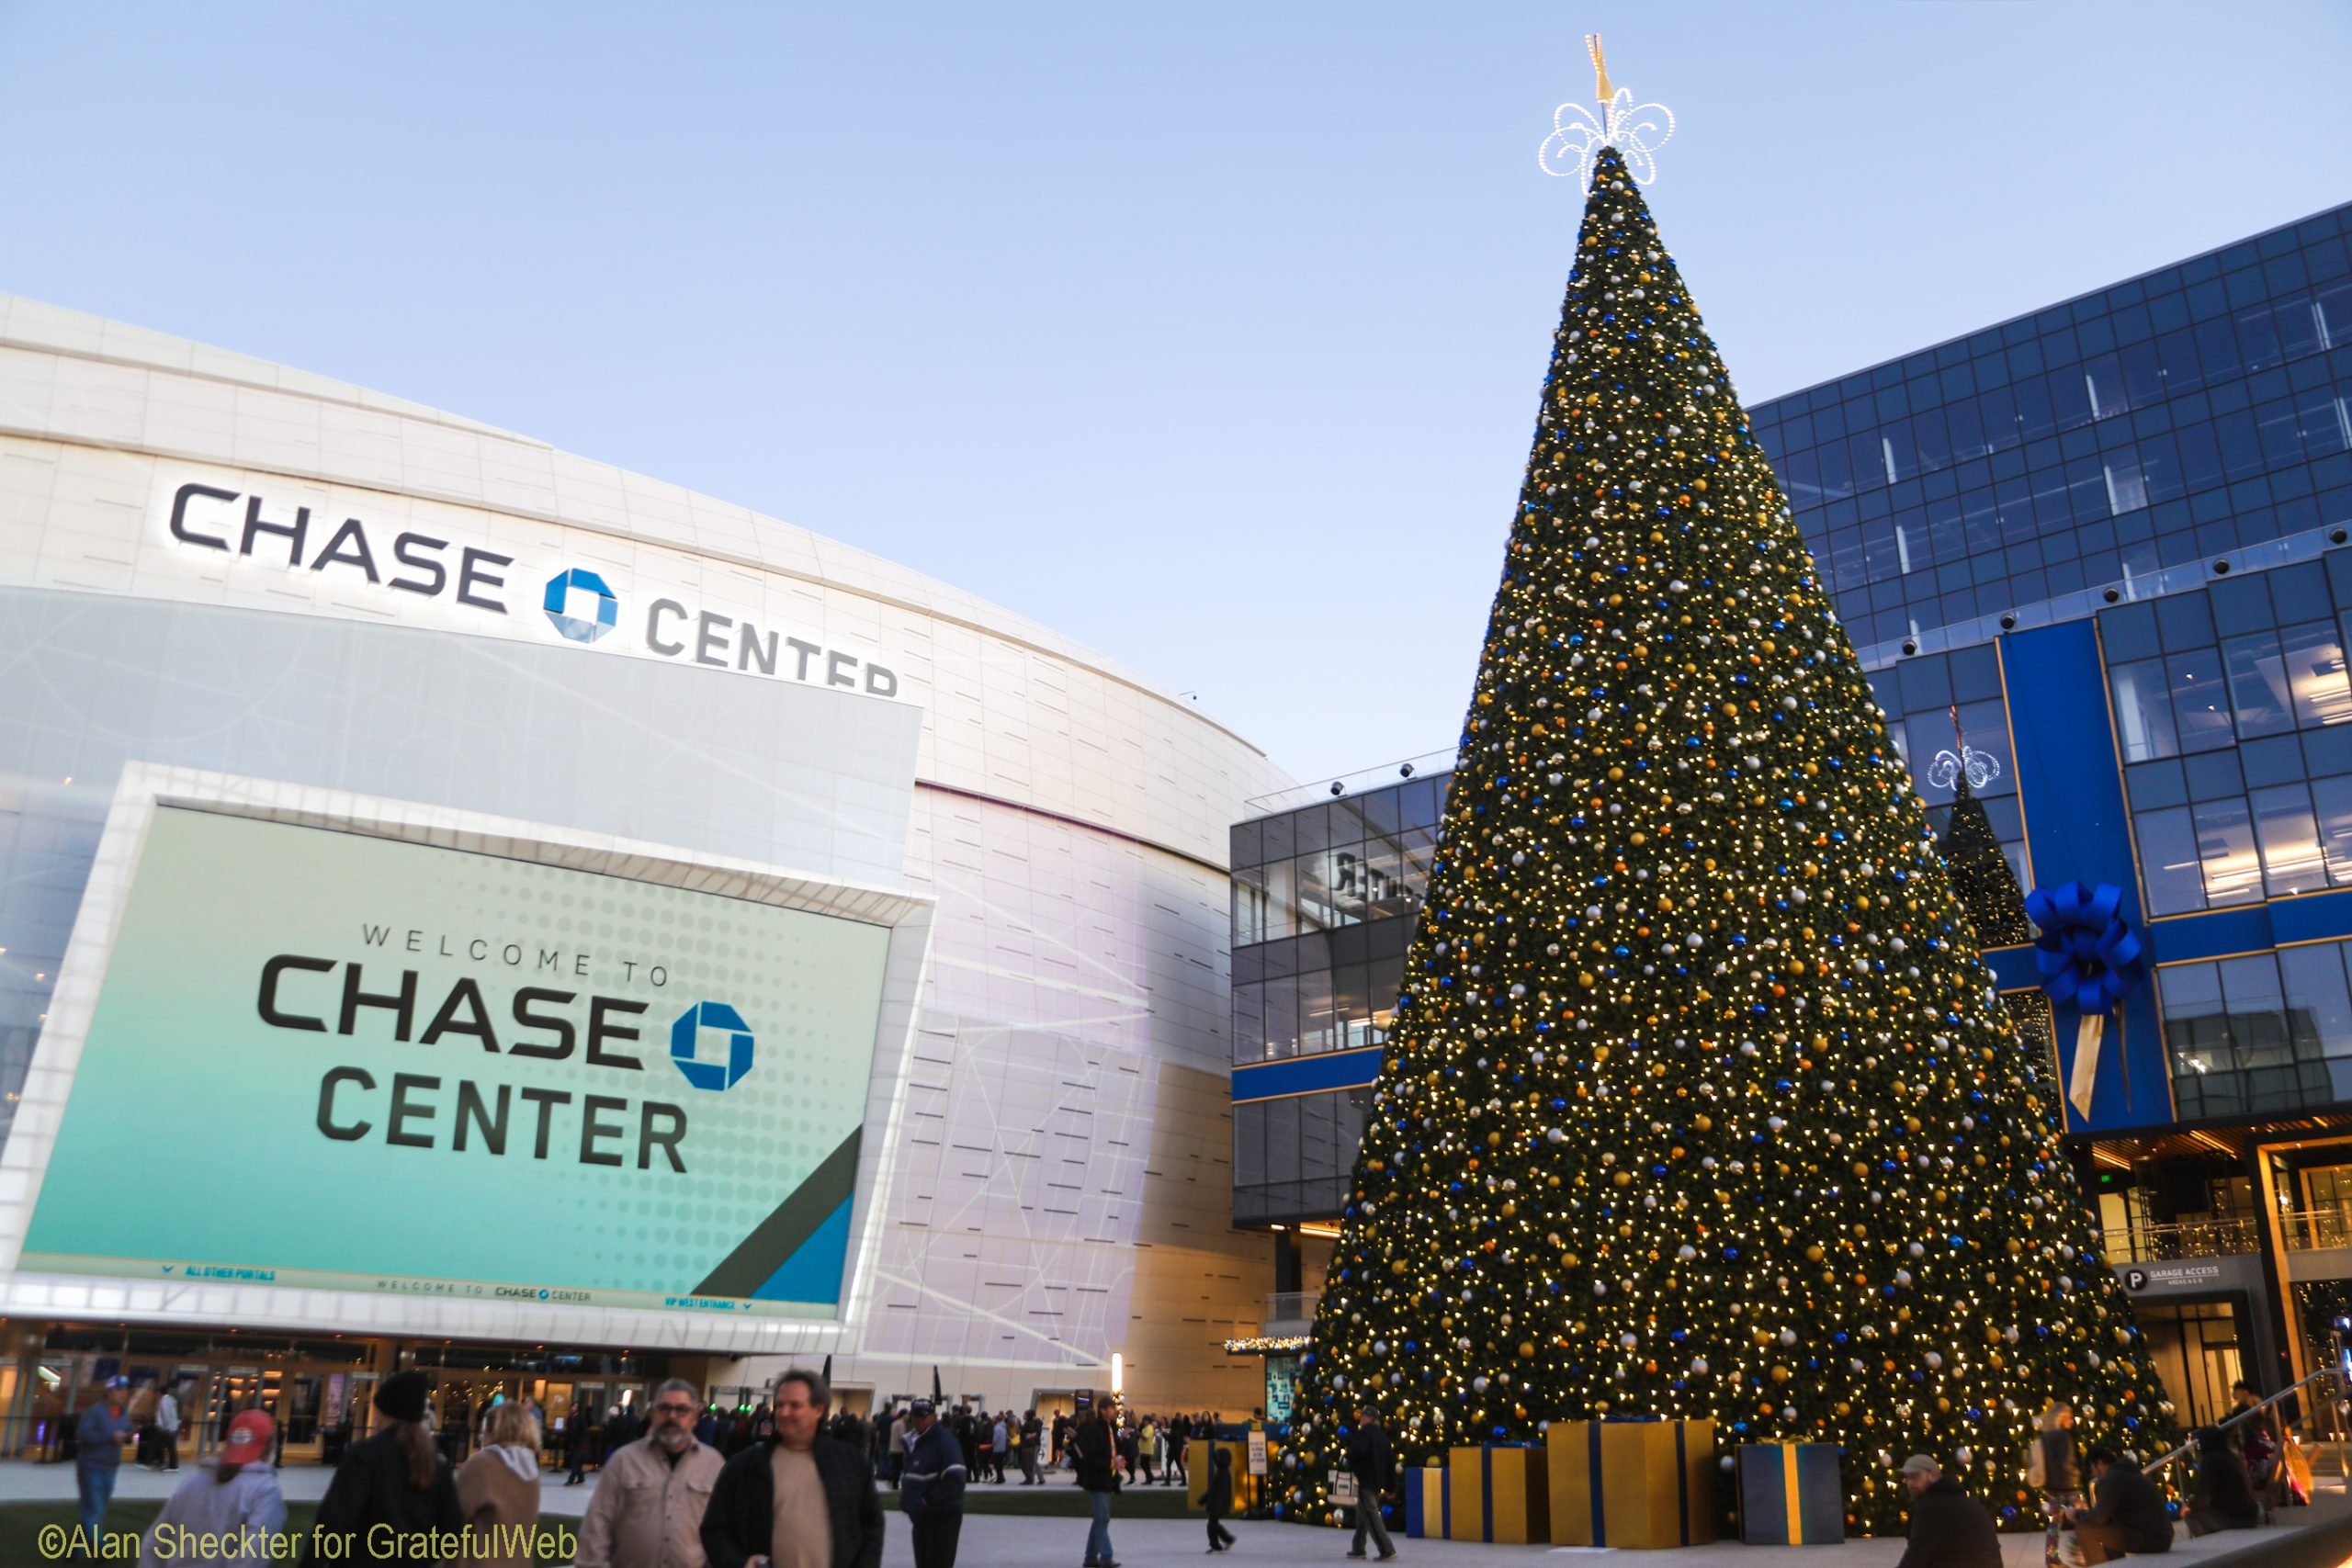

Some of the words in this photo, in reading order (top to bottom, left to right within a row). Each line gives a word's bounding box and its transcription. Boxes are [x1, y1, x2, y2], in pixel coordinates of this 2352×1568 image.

[170, 482, 514, 615] CHASE
[363, 923, 590, 976] WELCOME
[622, 962, 667, 987] TO
[257, 954, 650, 1070] CHASE
[316, 1066, 688, 1173] CENTER
[186, 1266, 201, 1276] ALL
[204, 1268, 232, 1279] OTHER
[235, 1269, 276, 1280] PORTALS
[378, 1280, 455, 1292] WELCOME
[466, 1285, 483, 1294] TO
[495, 1286, 536, 1298] CHASE
[552, 1290, 592, 1301] CENTER
[2150, 1269, 2183, 1278] GARAGE
[2186, 1266, 2219, 1276] ACCESS
